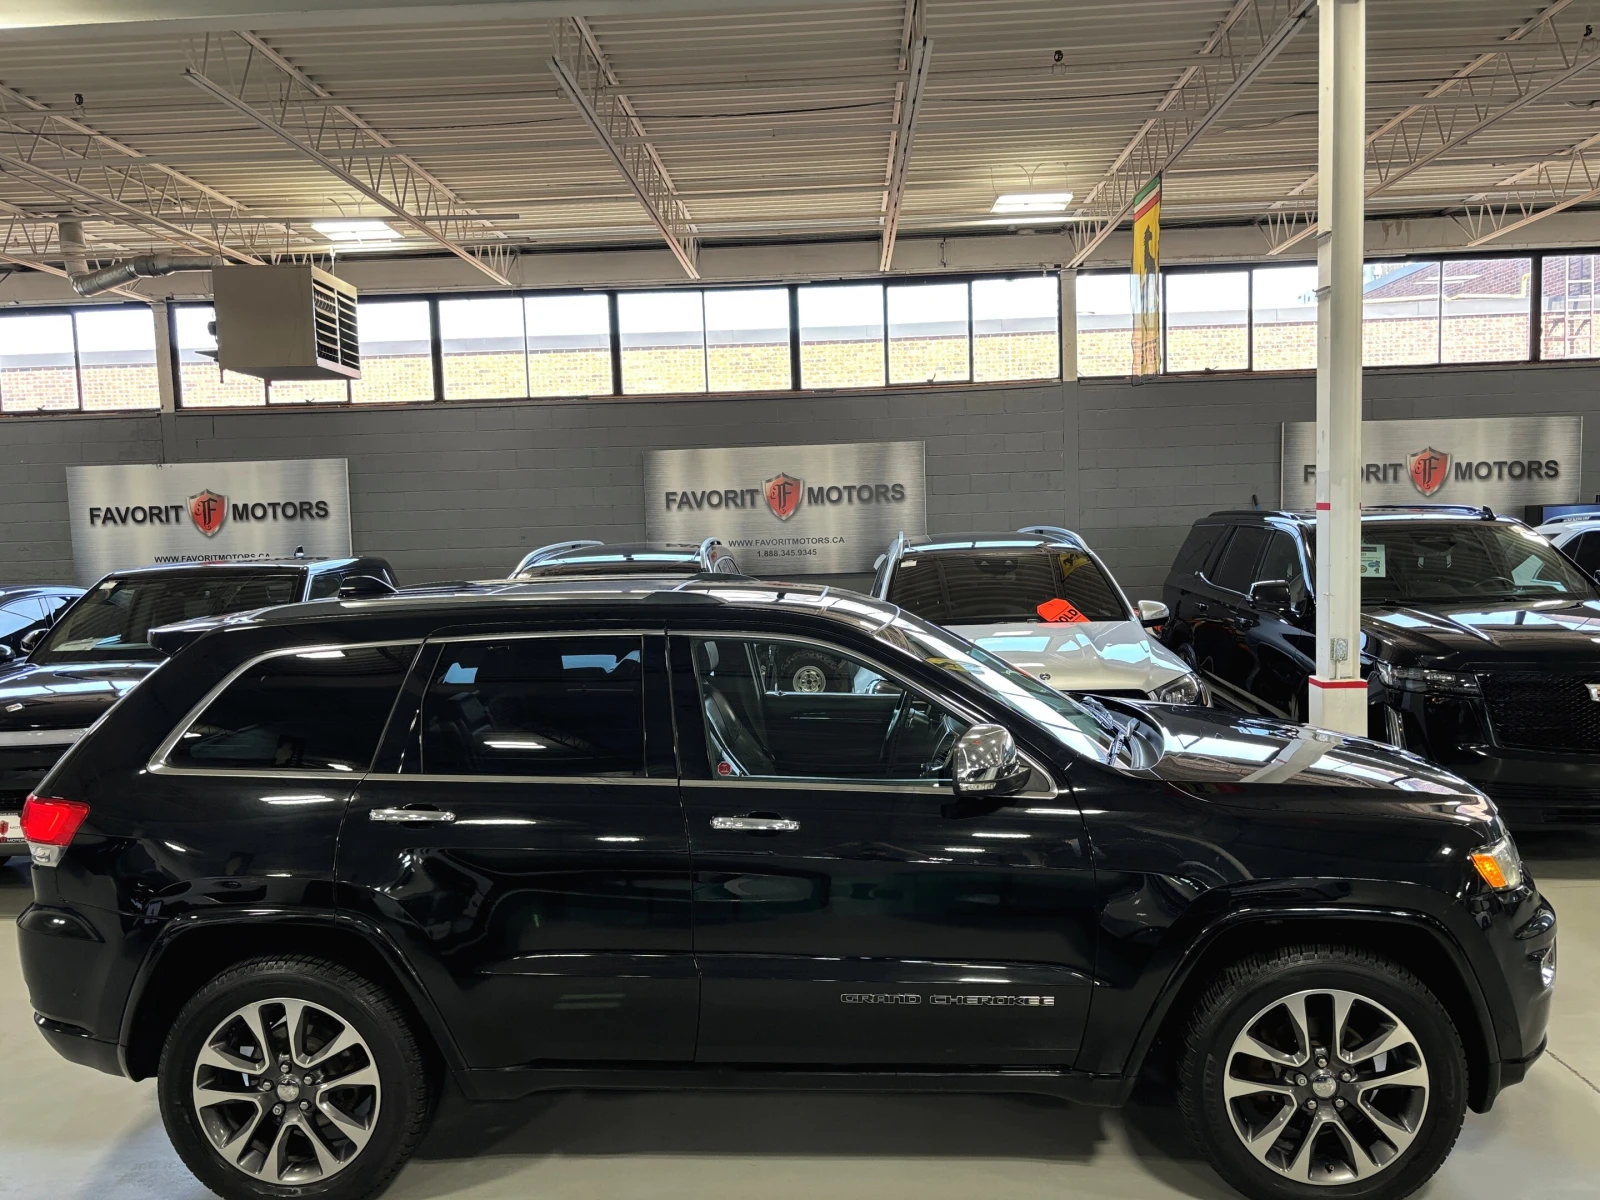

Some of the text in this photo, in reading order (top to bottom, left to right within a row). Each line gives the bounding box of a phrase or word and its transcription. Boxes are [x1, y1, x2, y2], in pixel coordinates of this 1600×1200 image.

[1303, 463, 1403, 482] FRIT
[1455, 460, 1559, 481] MOTORS
[665, 489, 759, 510] FAVORIT
[807, 484, 905, 505] MOTORS
[89, 505, 183, 525] FAVORIT
[232, 501, 329, 521] MOTORS
[728, 537, 845, 547] WWW.FAVORITMOTORS.CA
[154, 553, 271, 563] WWW.FAVORITMOTORSCA
[756, 549, 817, 558] 1.888.345.9345
[1054, 608, 1078, 622] OLD
[840, 993, 1055, 1006] GRAND CHEROKEE
